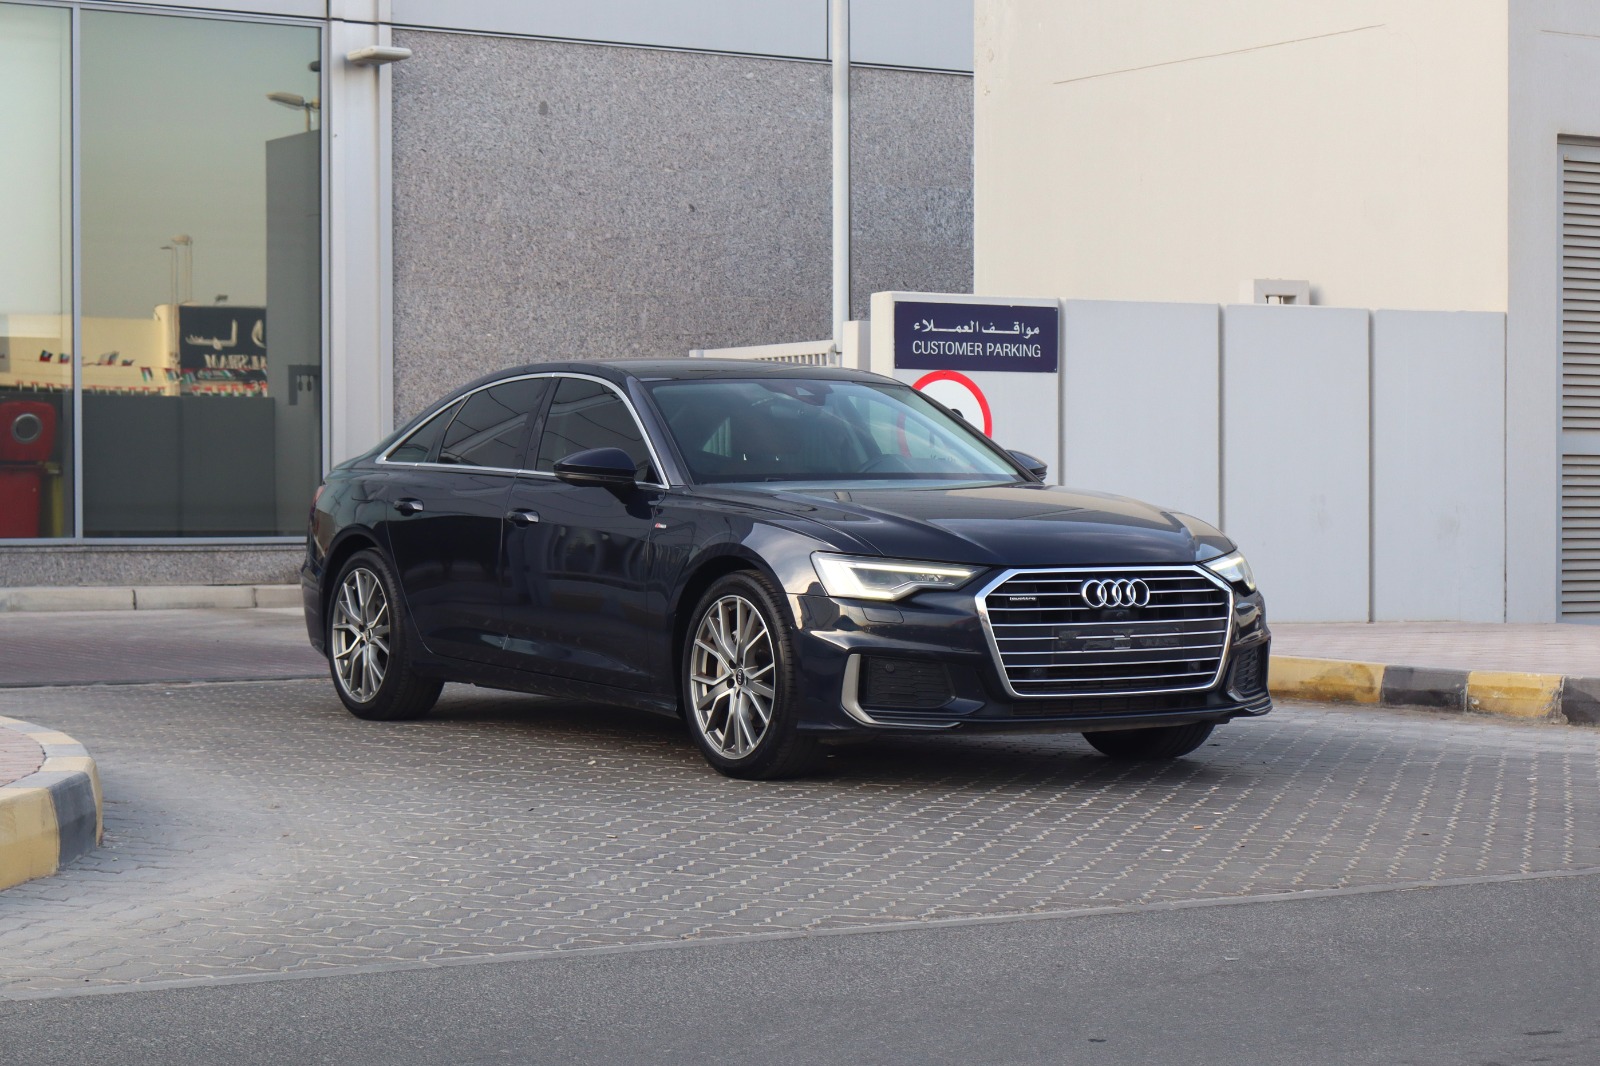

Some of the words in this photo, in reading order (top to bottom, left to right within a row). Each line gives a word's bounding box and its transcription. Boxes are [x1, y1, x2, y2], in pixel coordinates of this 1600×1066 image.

[913, 319, 979, 333] العملاء
[981, 321, 1040, 339] مواقف
[912, 340, 983, 356] CUSTOMER
[986, 342, 1041, 358] PARKING
